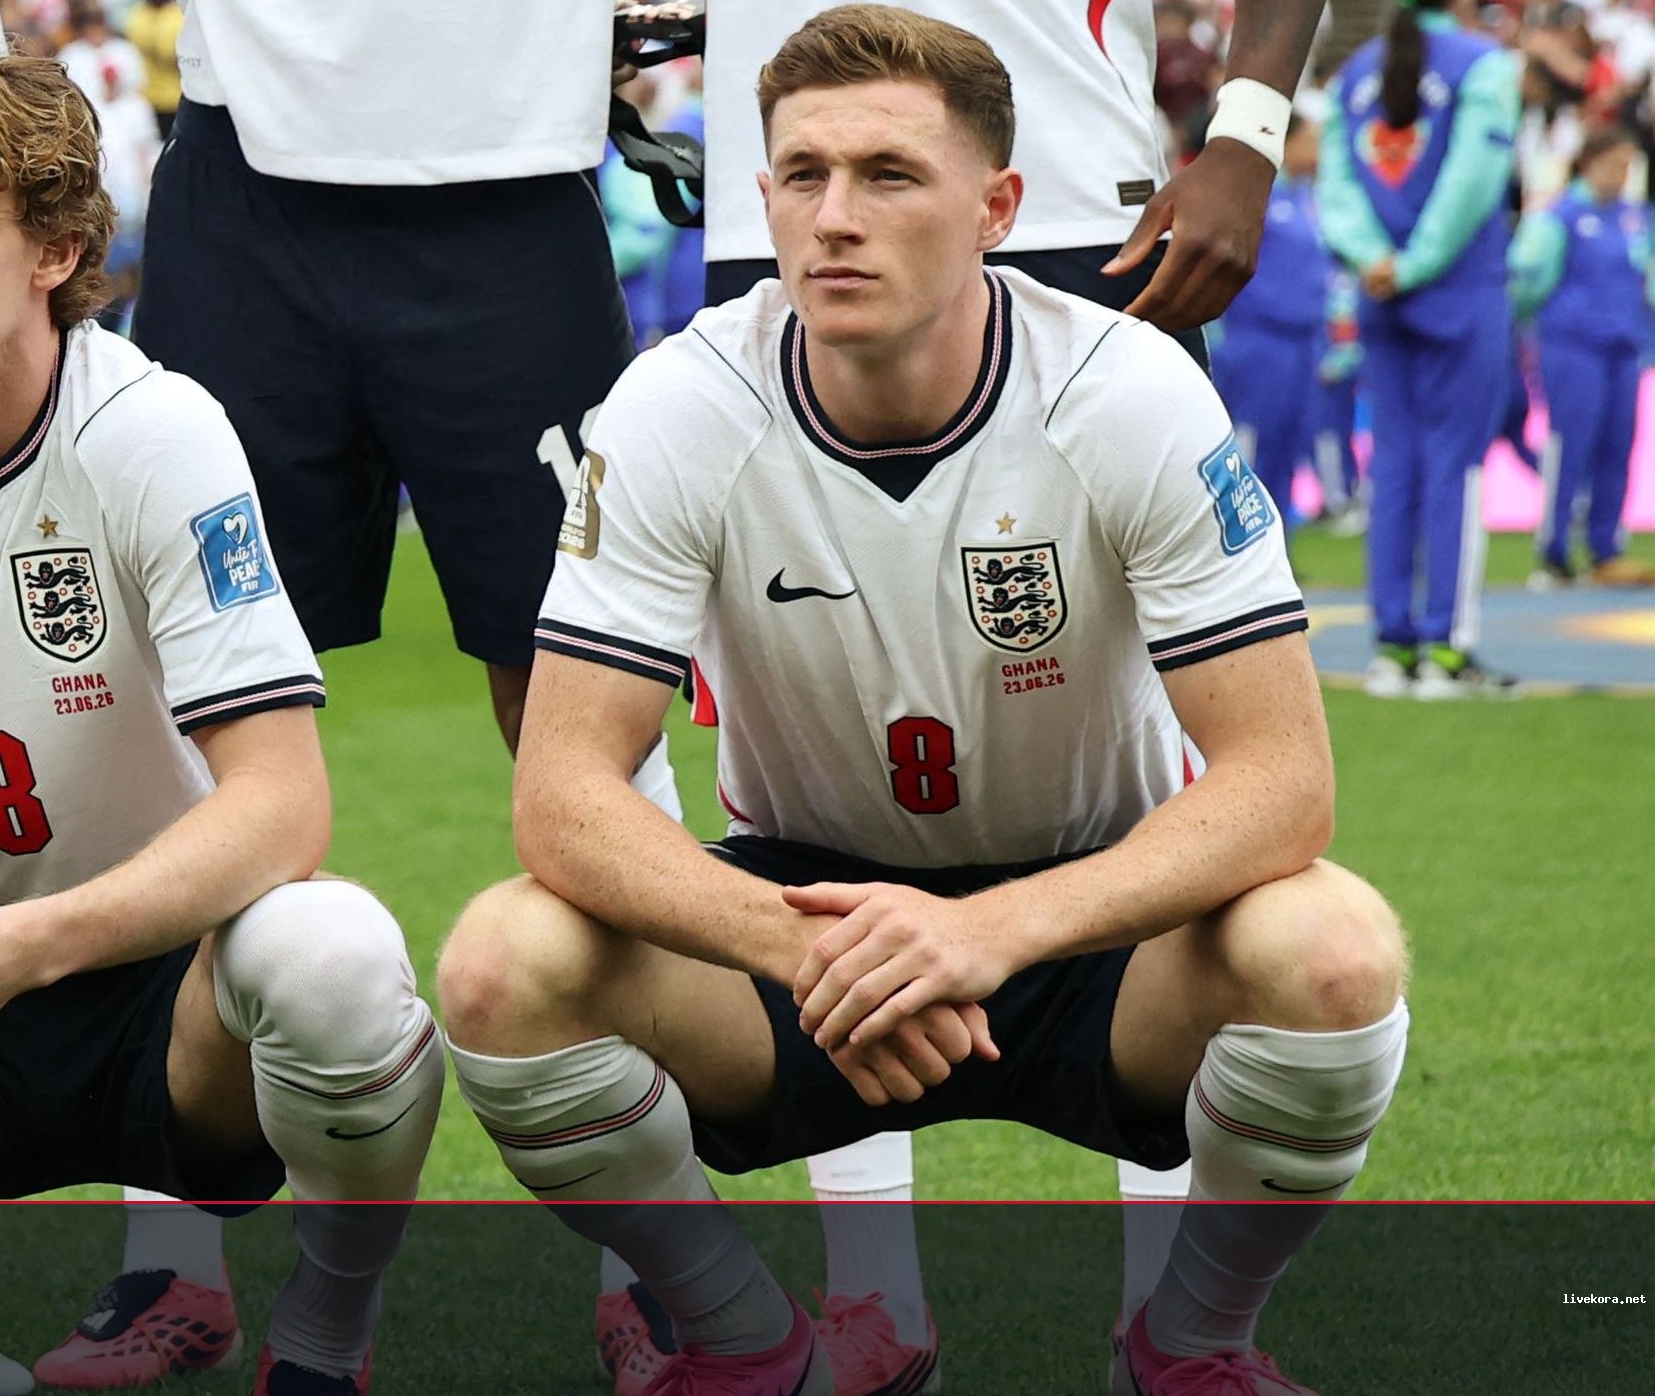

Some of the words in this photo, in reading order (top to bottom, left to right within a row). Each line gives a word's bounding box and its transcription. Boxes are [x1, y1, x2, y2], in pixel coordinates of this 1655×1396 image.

[1001, 656, 1061, 677] GHANA
[51, 672, 108, 694] GHANA
[1003, 672, 1066, 695] 23.06.26
[54, 691, 115, 716] 23.06.26
[887, 716, 960, 815] 8
